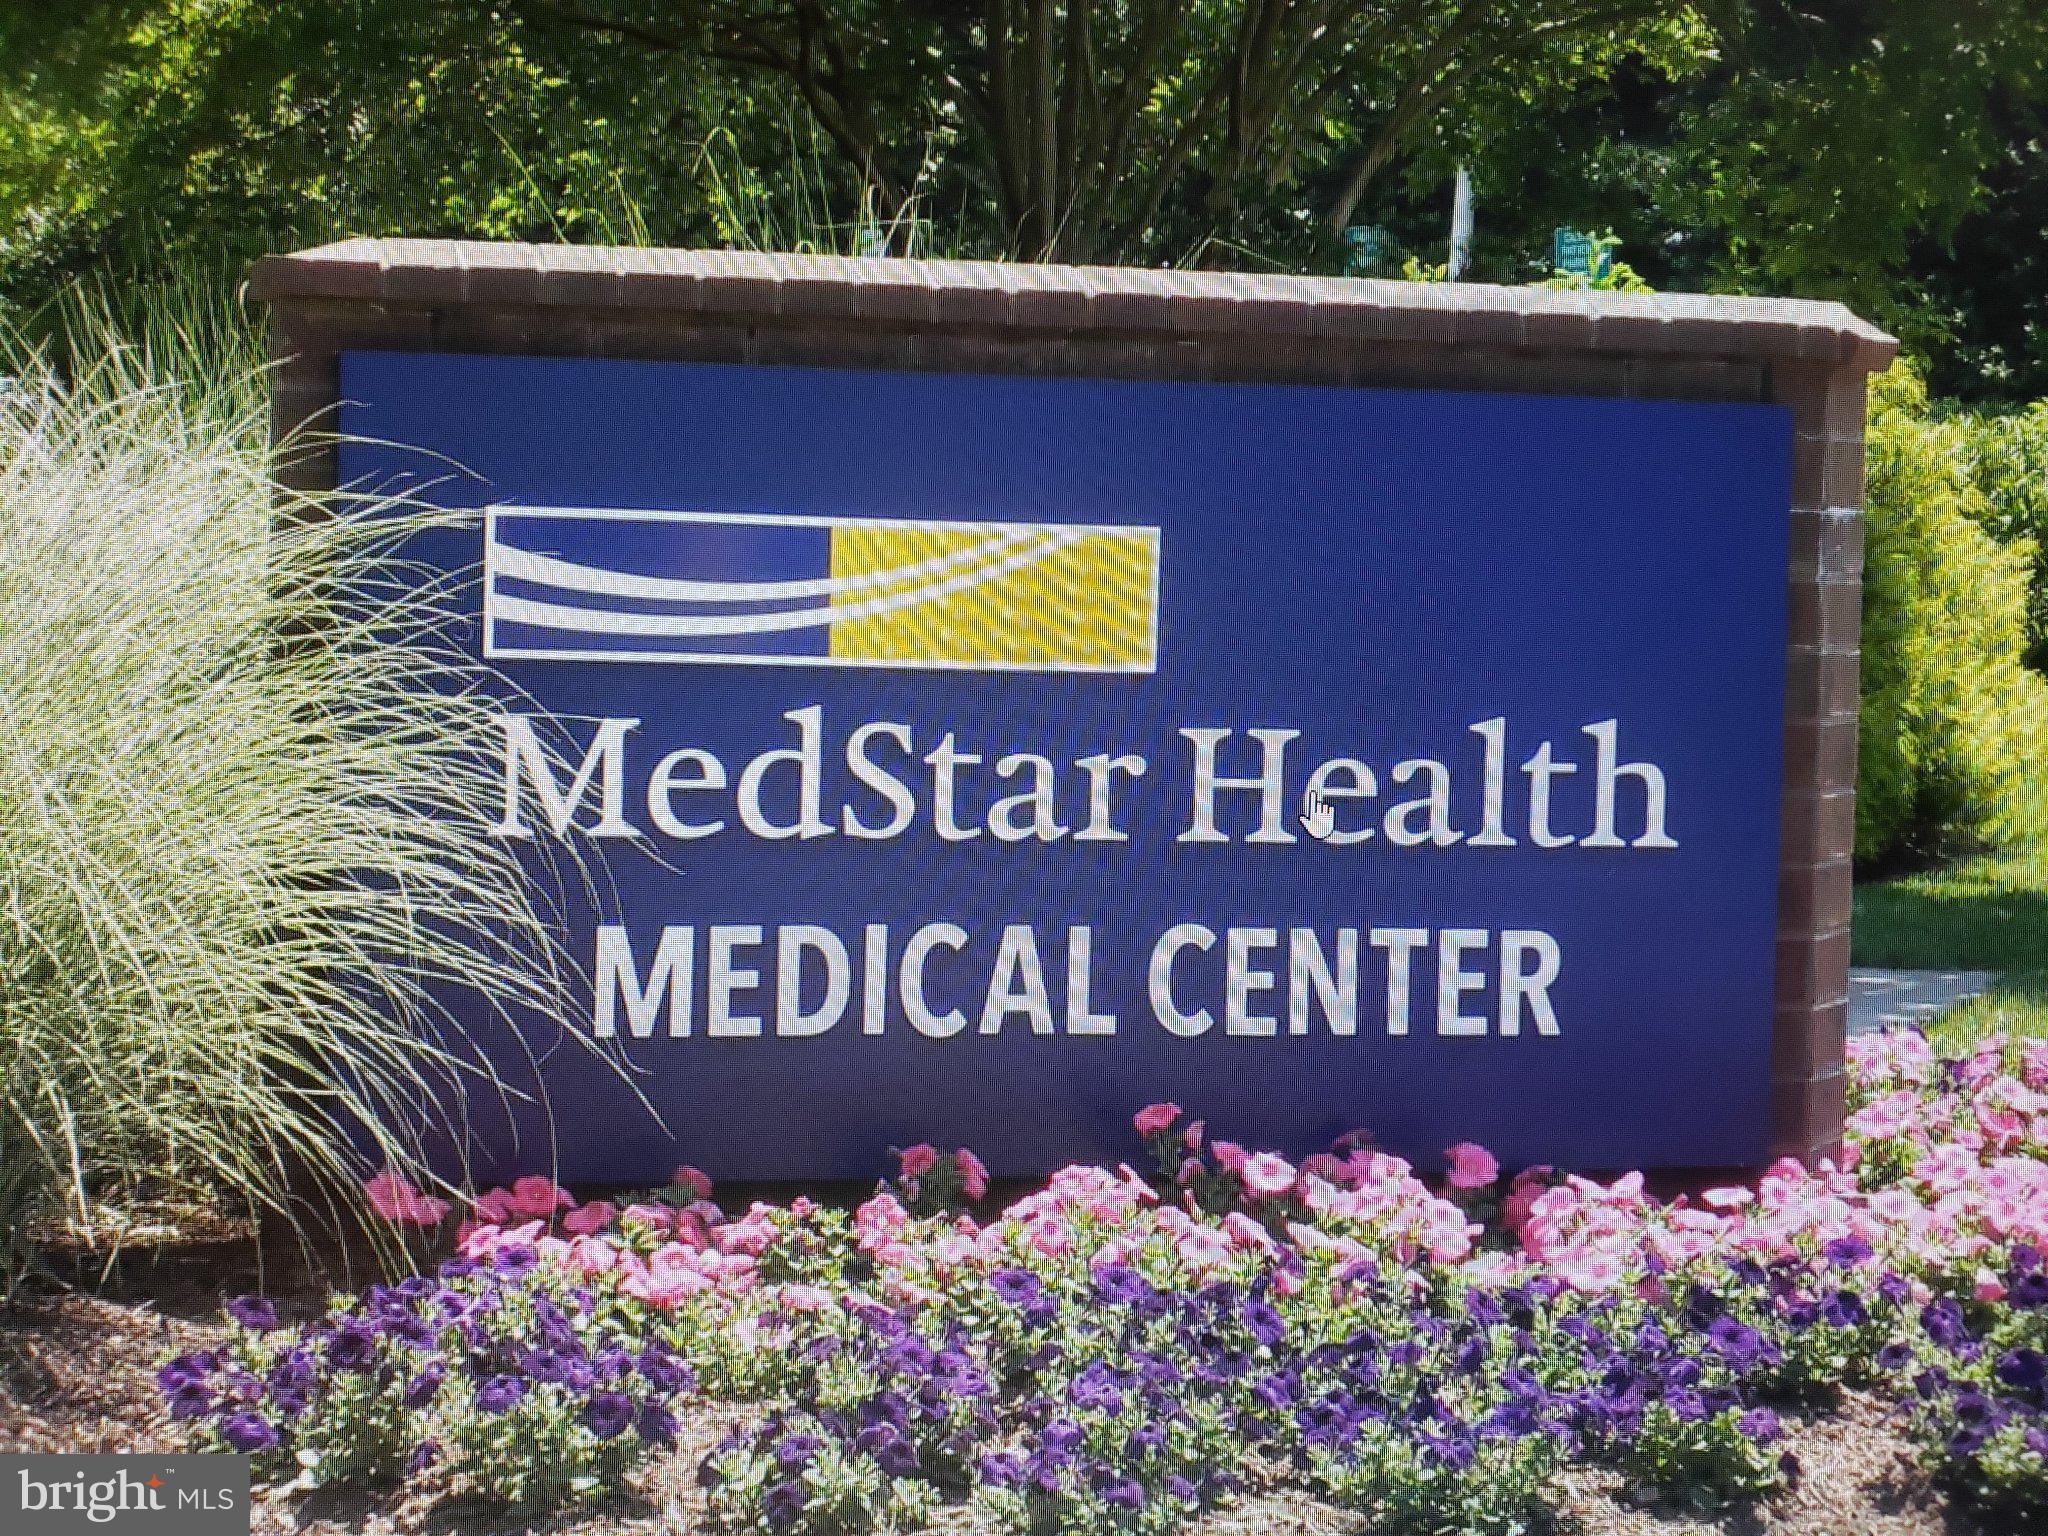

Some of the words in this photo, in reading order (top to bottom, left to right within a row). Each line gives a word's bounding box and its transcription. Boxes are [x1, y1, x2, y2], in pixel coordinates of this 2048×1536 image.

[487, 704, 1147, 842] MedStar
[1176, 716, 1680, 849] Health
[594, 922, 1118, 1039] MEDICAL
[1147, 923, 1562, 1039] CENTER
